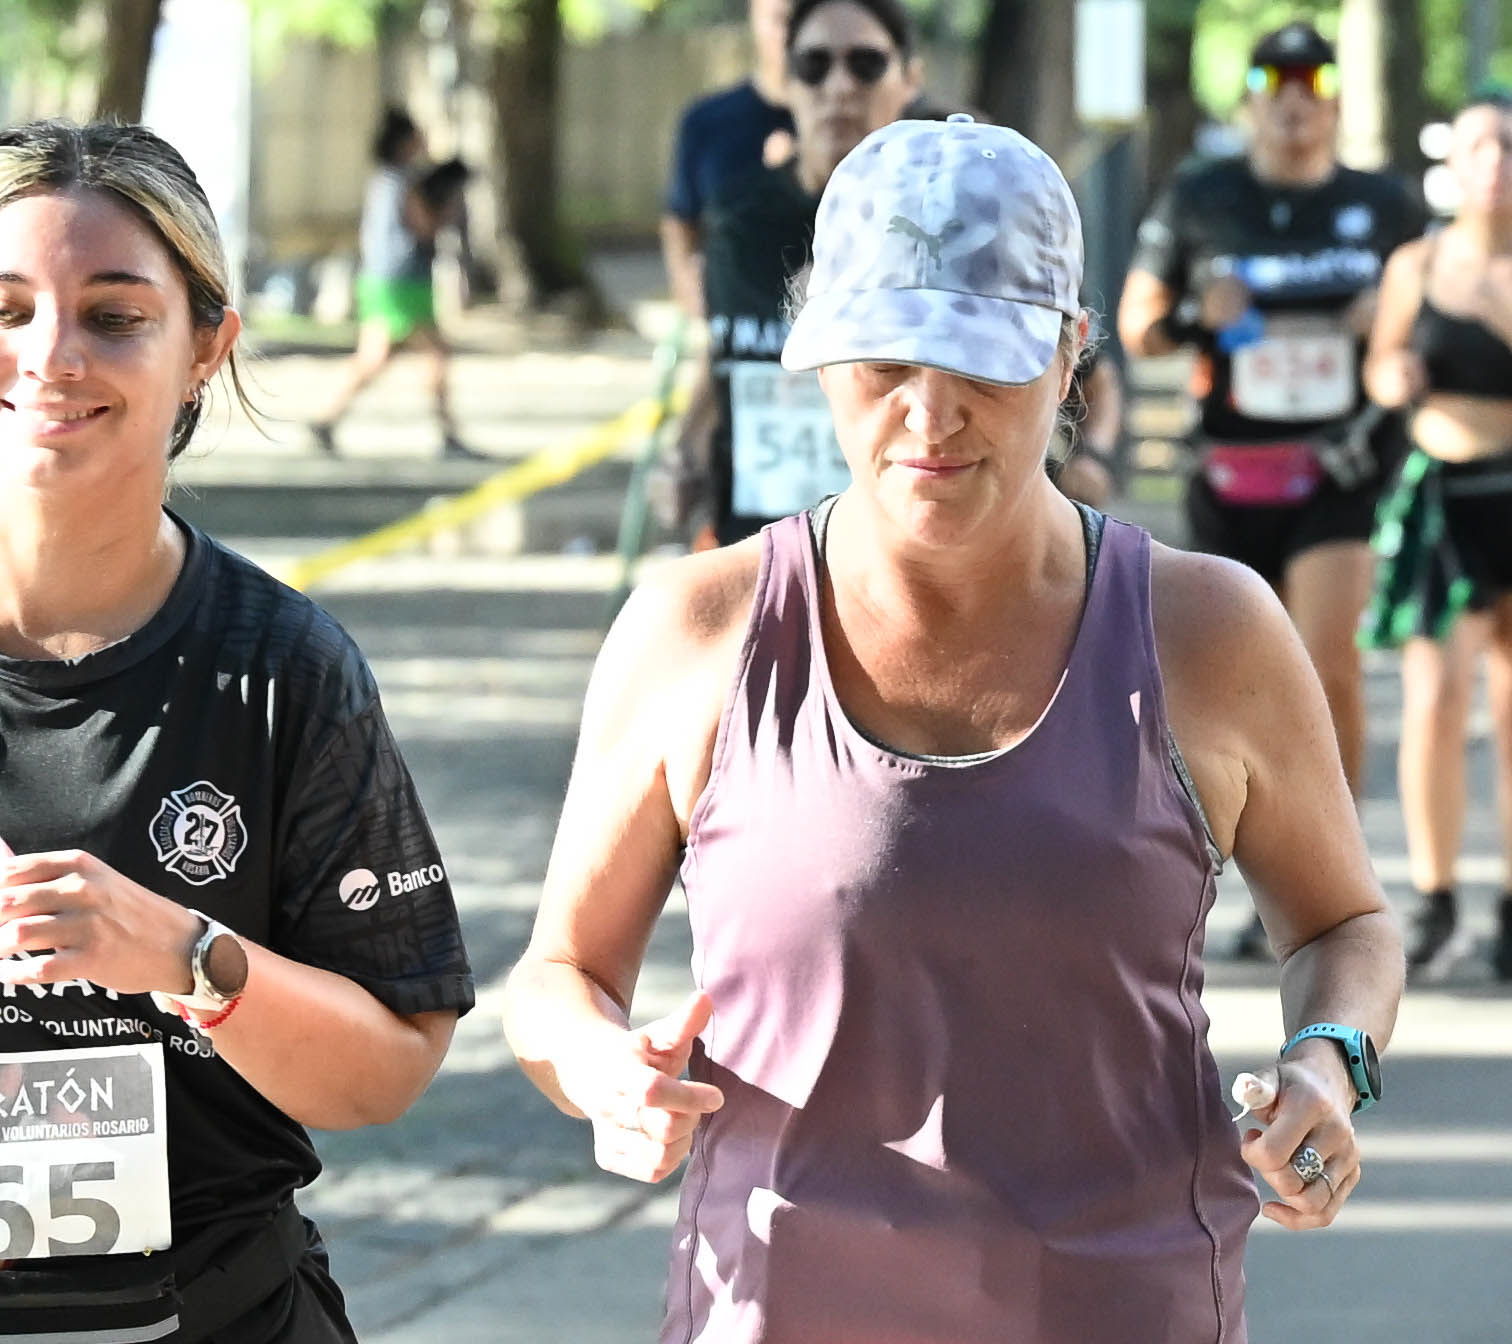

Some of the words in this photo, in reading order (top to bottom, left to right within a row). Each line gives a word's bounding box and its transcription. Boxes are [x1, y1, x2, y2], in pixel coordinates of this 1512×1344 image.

[183, 811, 219, 846] 27
[387, 864, 444, 897] Banco
[40, 1016, 163, 1042] OLUNTARIOS
[1, 1120, 89, 1142] VOLUNTARIOS
[92, 1116, 149, 1136] ROSARIO
